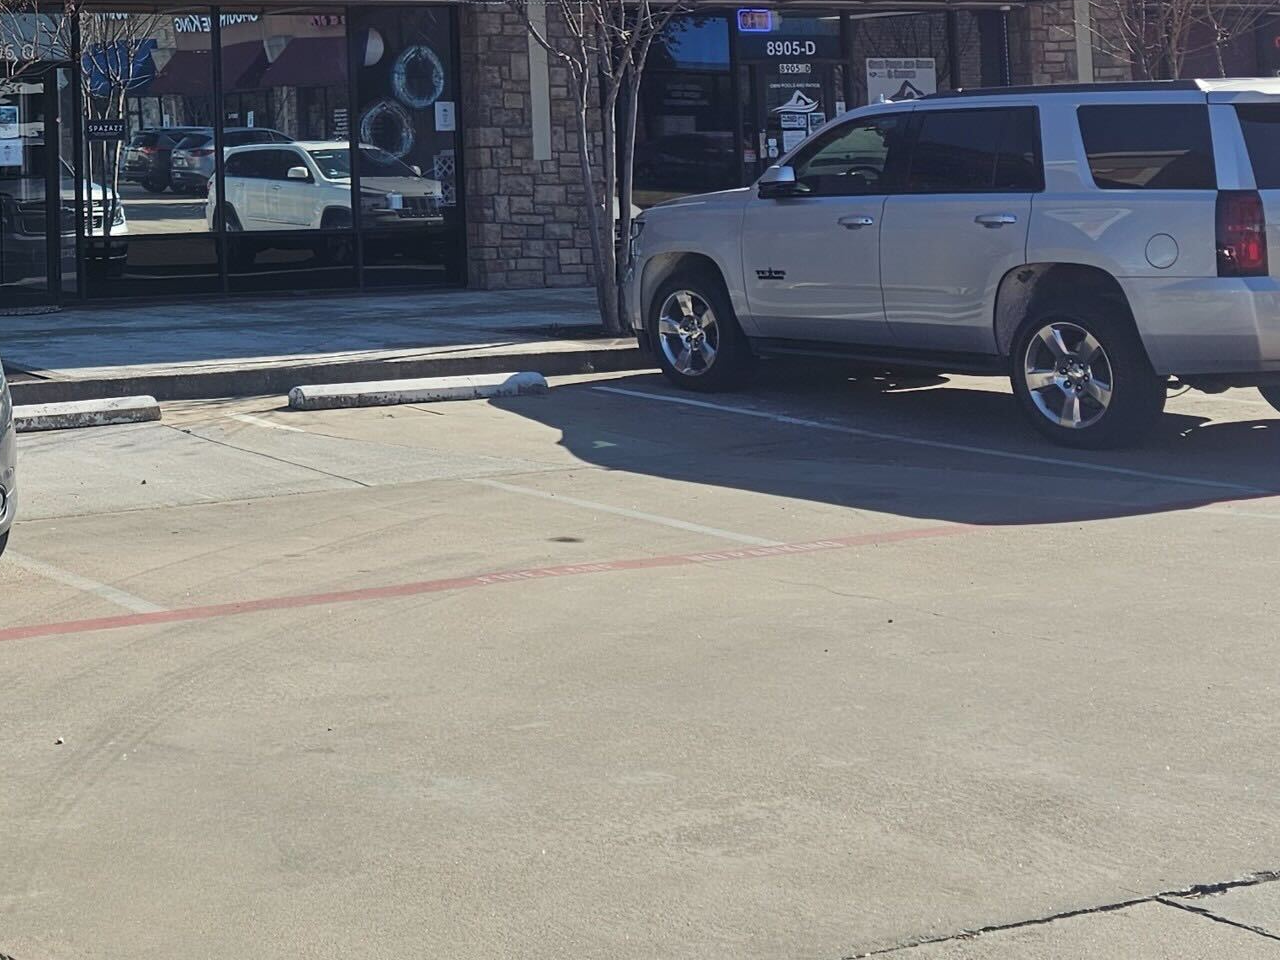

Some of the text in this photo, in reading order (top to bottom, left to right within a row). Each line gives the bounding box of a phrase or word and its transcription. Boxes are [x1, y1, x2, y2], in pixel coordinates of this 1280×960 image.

[766, 41, 816, 56] 8905-D
[780, 64, 801, 74] 8905
[88, 124, 123, 132] SPAZAZZ
